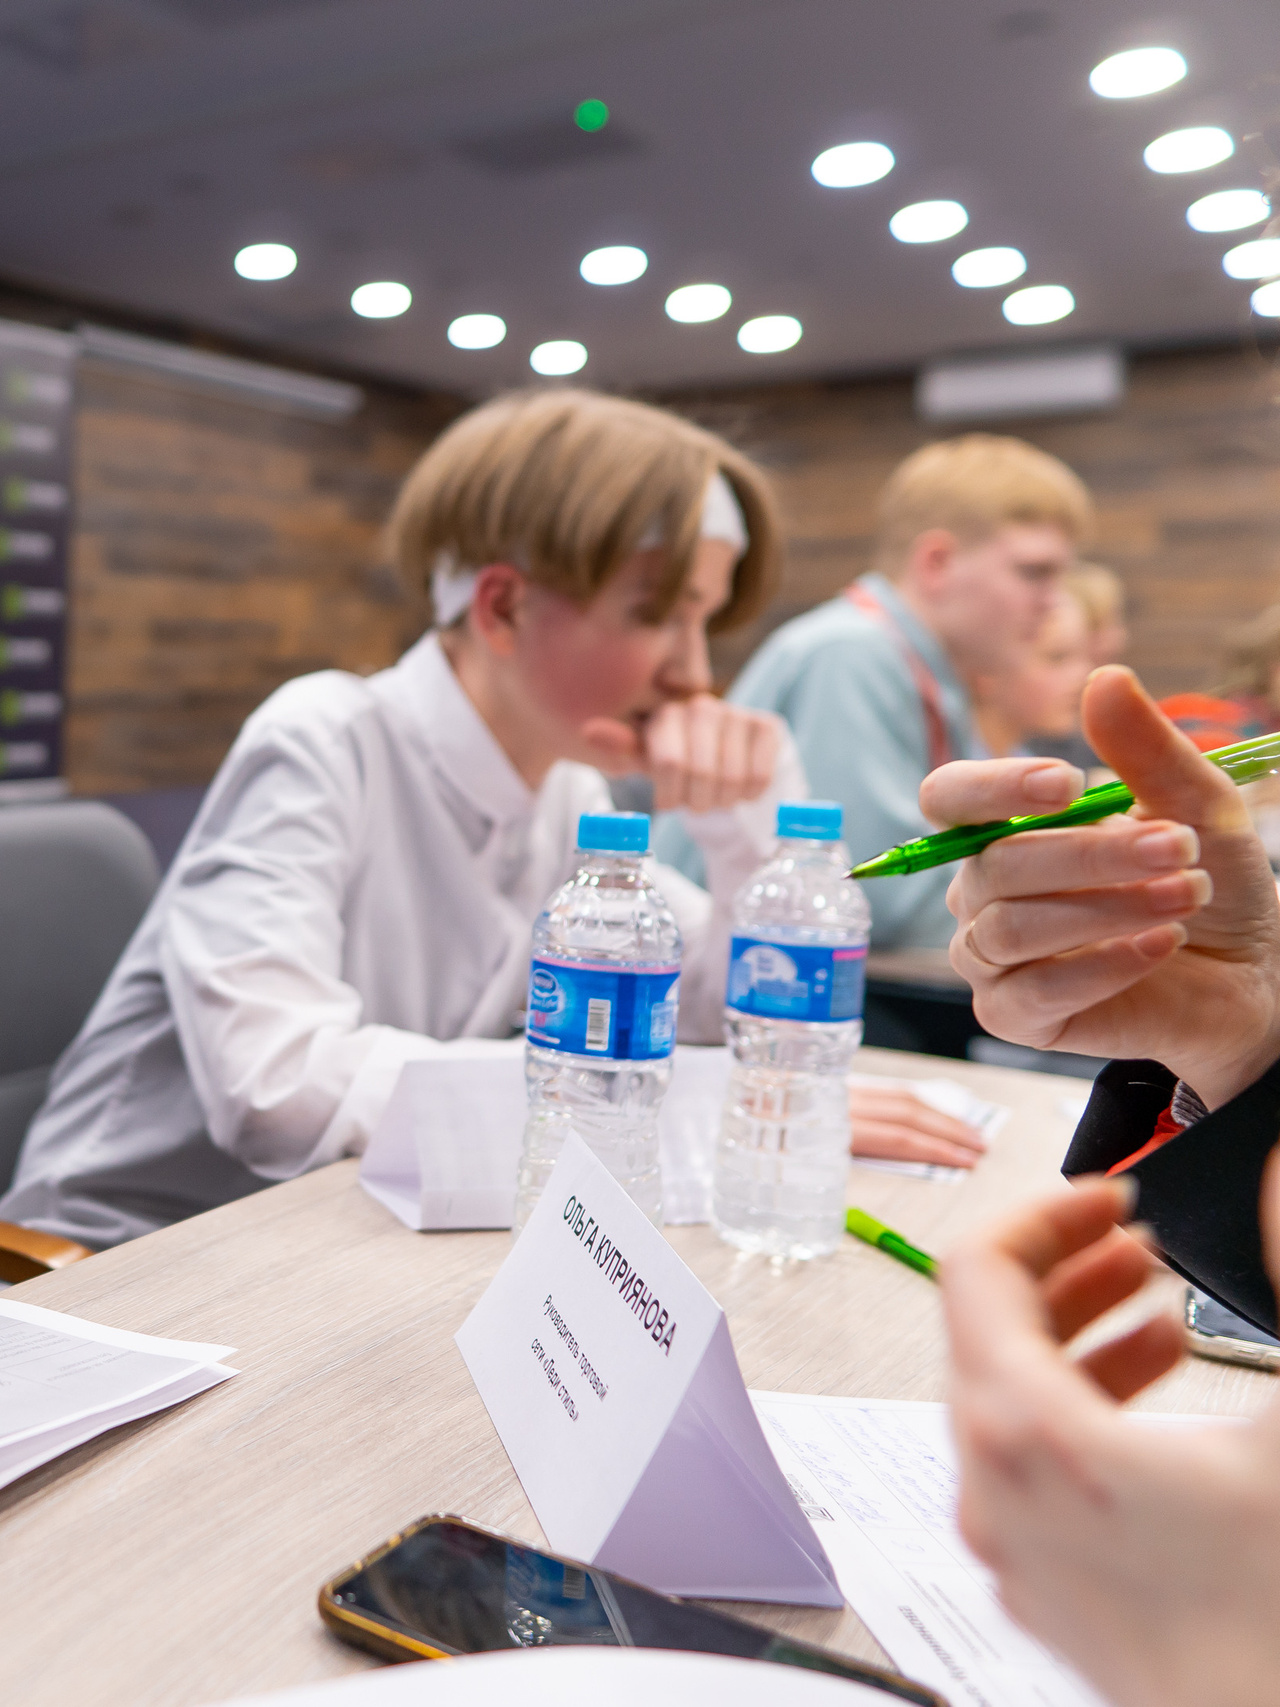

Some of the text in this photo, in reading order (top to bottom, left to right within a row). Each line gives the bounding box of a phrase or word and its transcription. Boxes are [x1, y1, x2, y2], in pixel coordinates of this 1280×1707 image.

[563, 1195, 677, 1358] ОЛЬГА КУПРИЯНОВА
[531, 1338, 580, 1422] сети «Леди стиль»
[543, 1294, 609, 1402] Руководитель торговой
